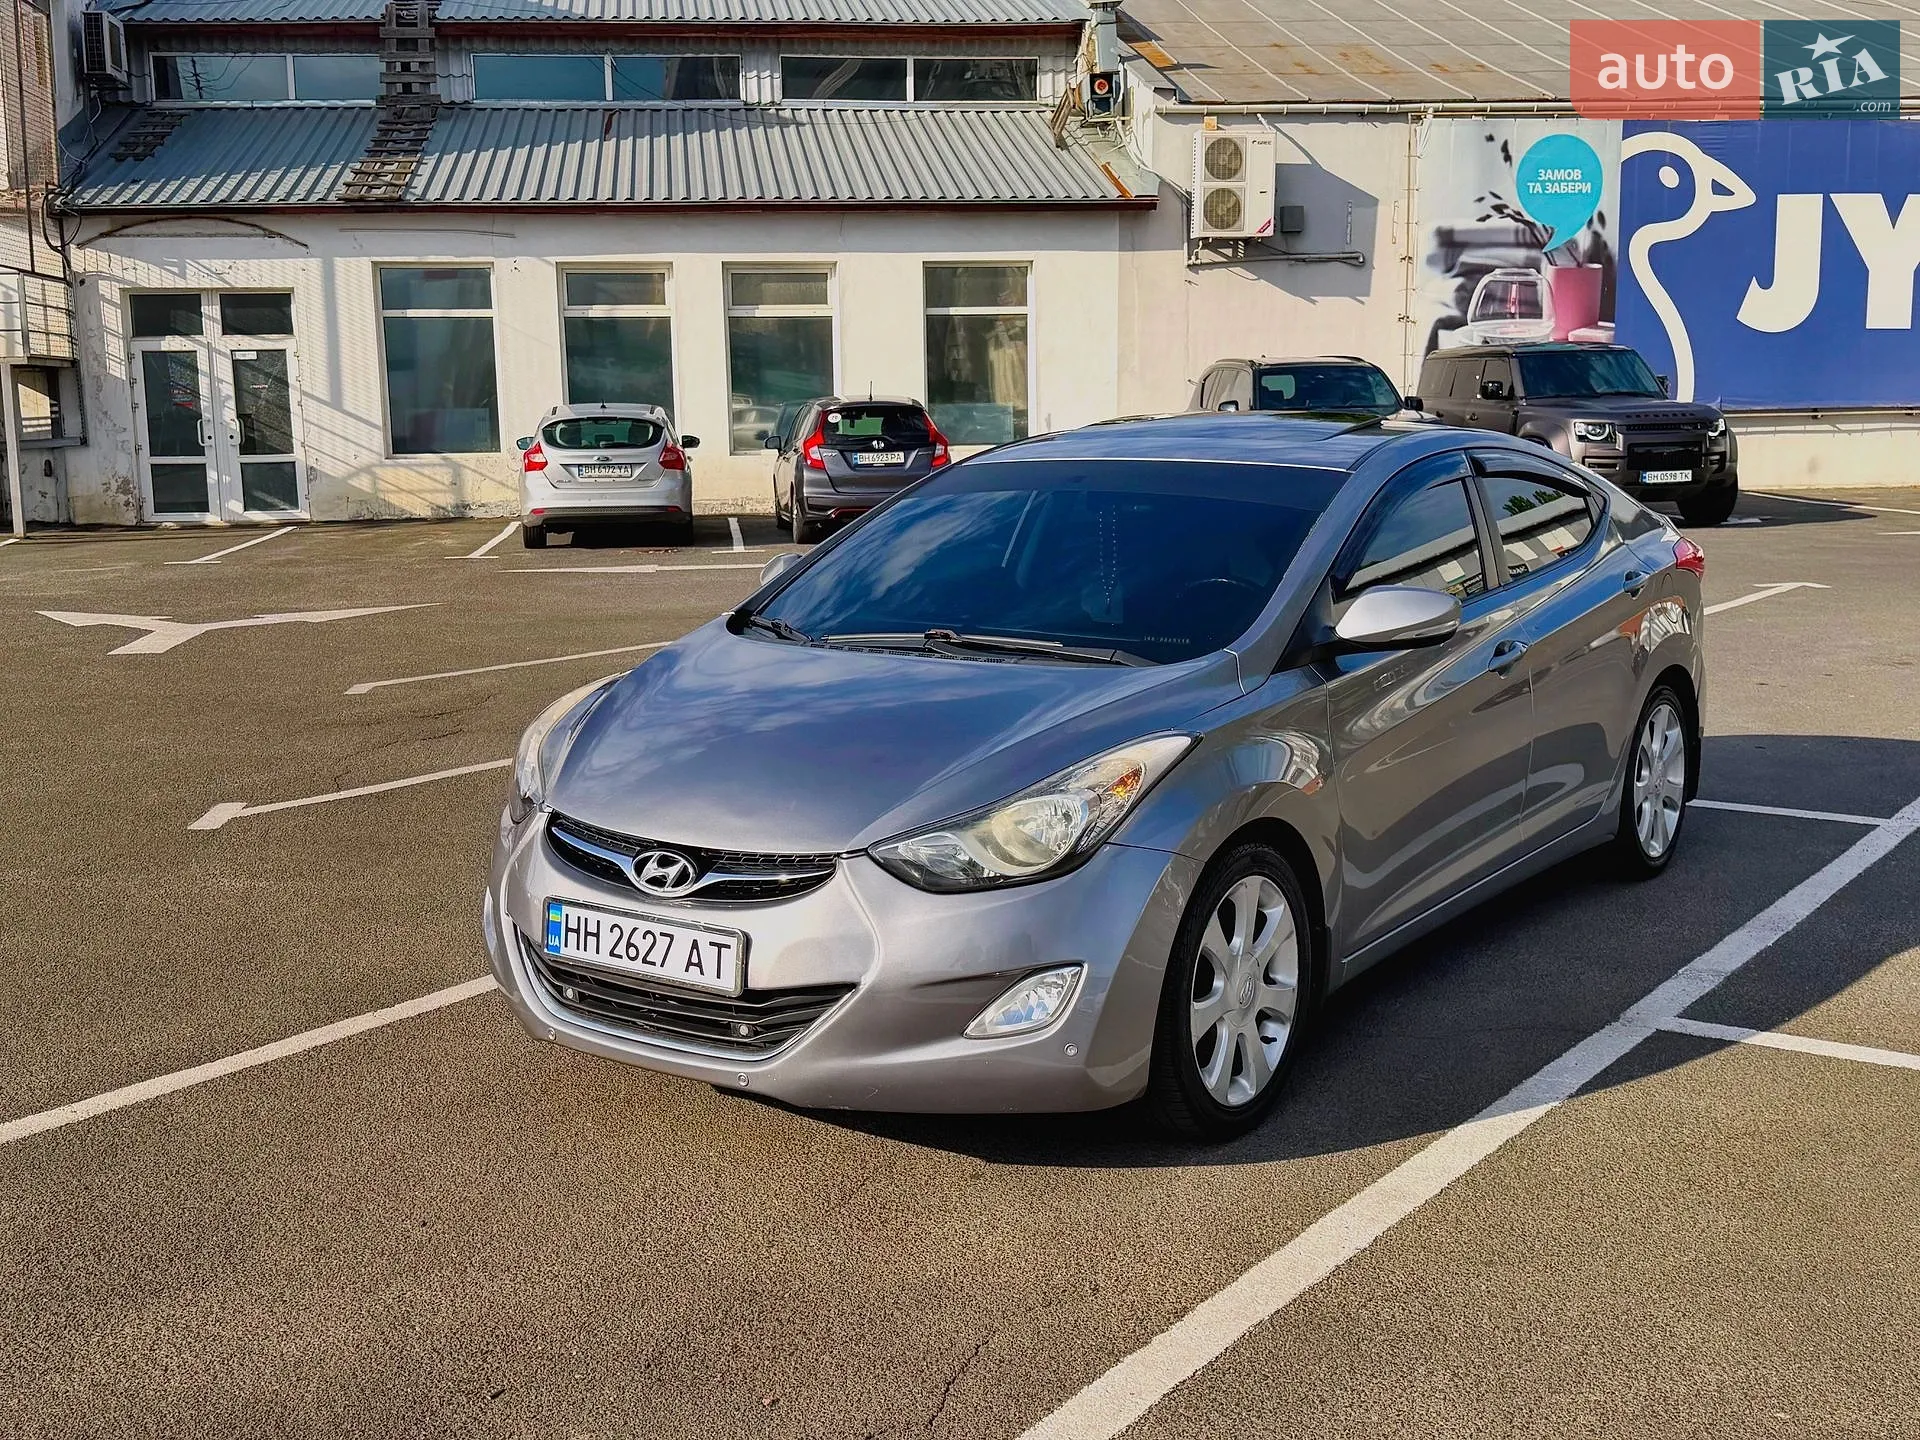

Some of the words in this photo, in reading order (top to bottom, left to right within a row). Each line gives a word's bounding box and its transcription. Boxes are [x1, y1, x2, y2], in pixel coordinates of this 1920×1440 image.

[1537, 168, 1582, 181] ЗАМОВ
[1527, 182, 1543, 194] ТА
[1544, 182, 1592, 194] ЗАБЕРИ
[1736, 193, 1920, 333] JY
[1647, 473, 1659, 481] BH
[1679, 472, 1690, 480] TK
[548, 934, 560, 947] UA
[564, 913, 601, 955] HH
[608, 923, 675, 968] 2627
[684, 939, 731, 979] AT
